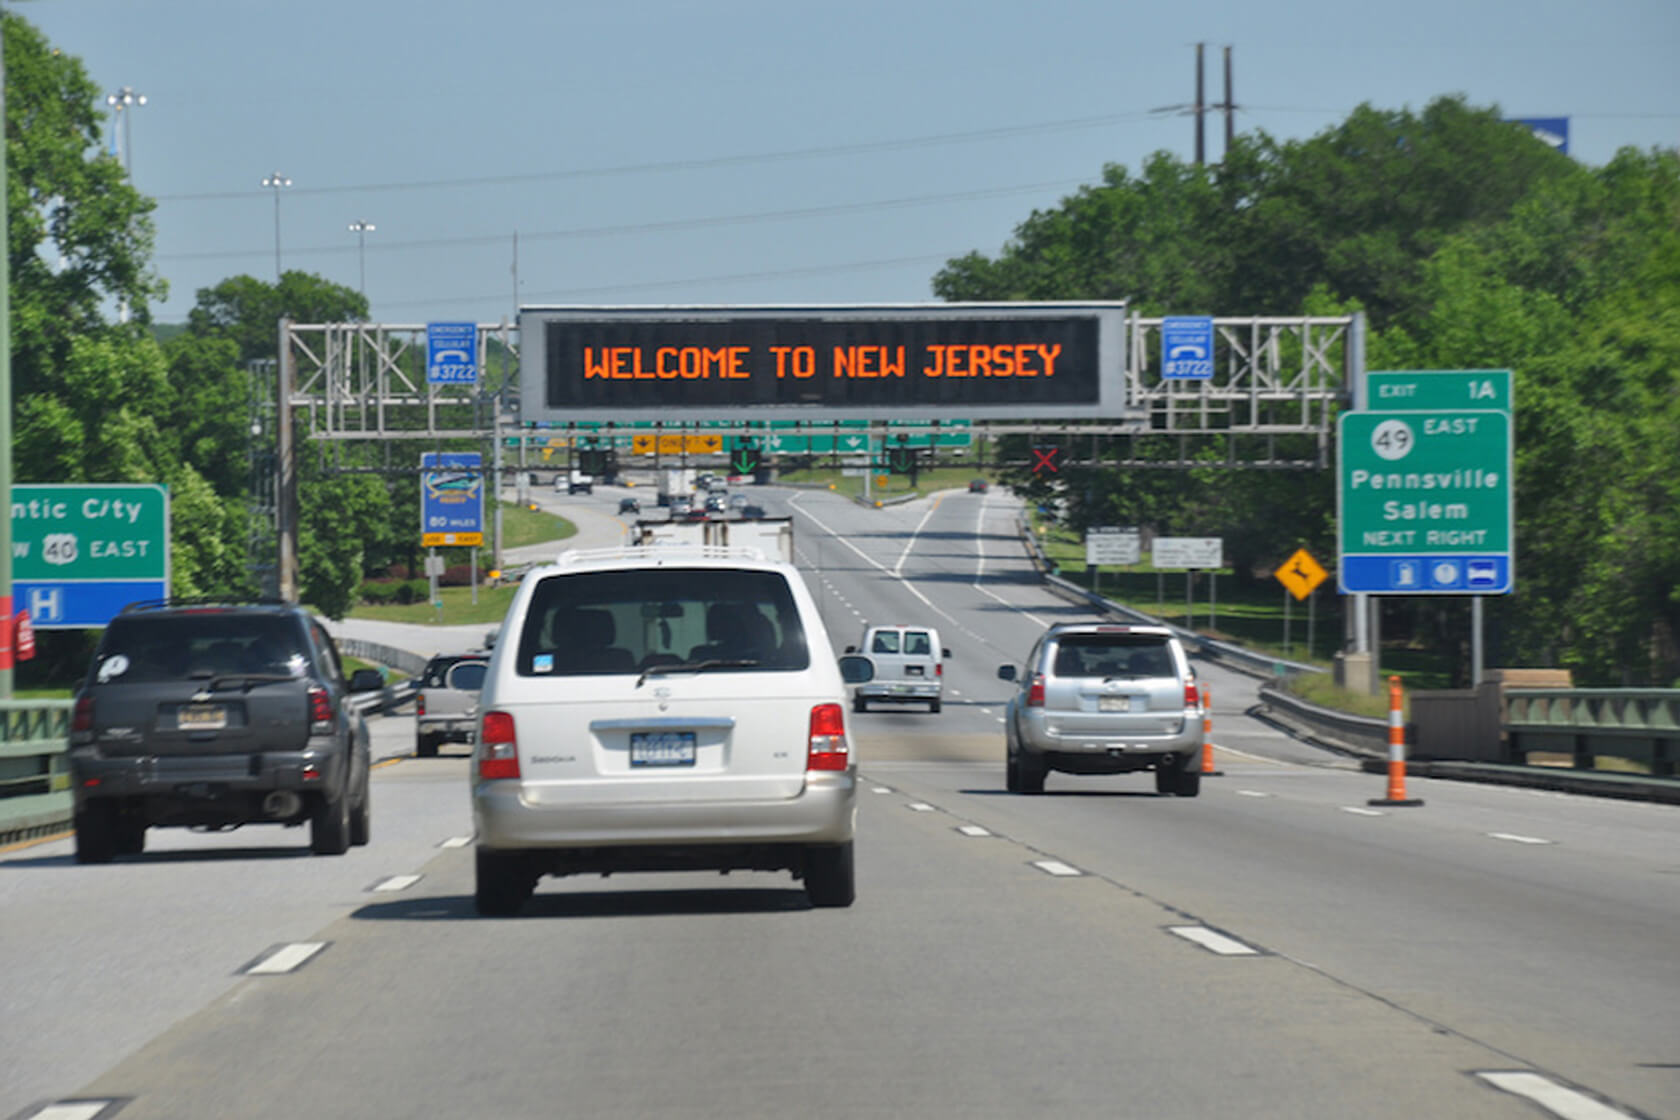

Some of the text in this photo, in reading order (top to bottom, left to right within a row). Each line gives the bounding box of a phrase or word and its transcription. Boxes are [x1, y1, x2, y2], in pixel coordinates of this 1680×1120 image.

[431, 364, 475, 379] #3722
[583, 343, 1062, 381] WELCOME TO NEW JERSEY
[1165, 360, 1209, 375] #3722
[1379, 381, 1496, 400] EXIT 1A
[1375, 418, 1479, 450] 49 EAST
[1351, 470, 1500, 490] Pennsville
[82, 498, 142, 524] City
[1383, 501, 1469, 520] Salem
[1363, 530, 1487, 546] NEXT RIGHT
[45, 542, 75, 559] 40
[90, 540, 150, 558] EAST
